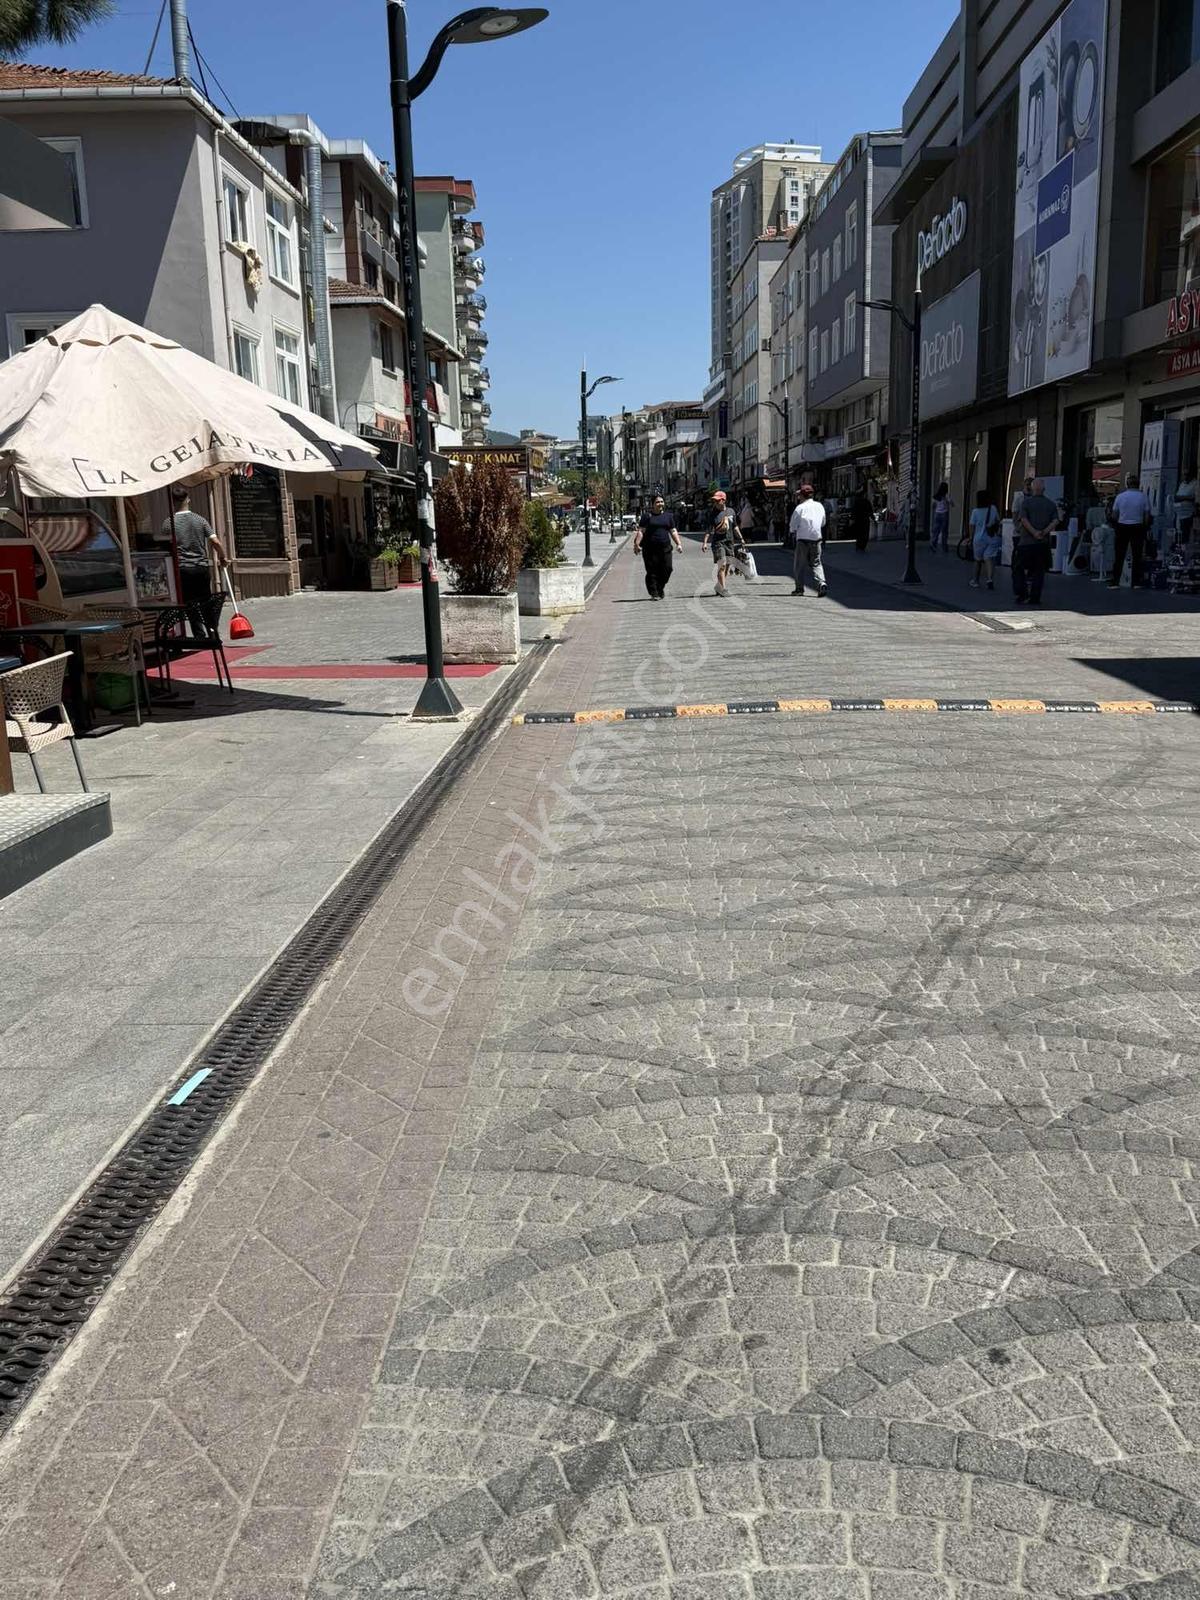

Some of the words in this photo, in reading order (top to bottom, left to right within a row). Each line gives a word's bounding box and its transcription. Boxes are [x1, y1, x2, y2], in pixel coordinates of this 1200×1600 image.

[917, 196, 967, 275] DeFacto
[921, 320, 964, 380] DeFacto
[1171, 352, 1191, 374] ASYA
[96, 469, 141, 485] LA
